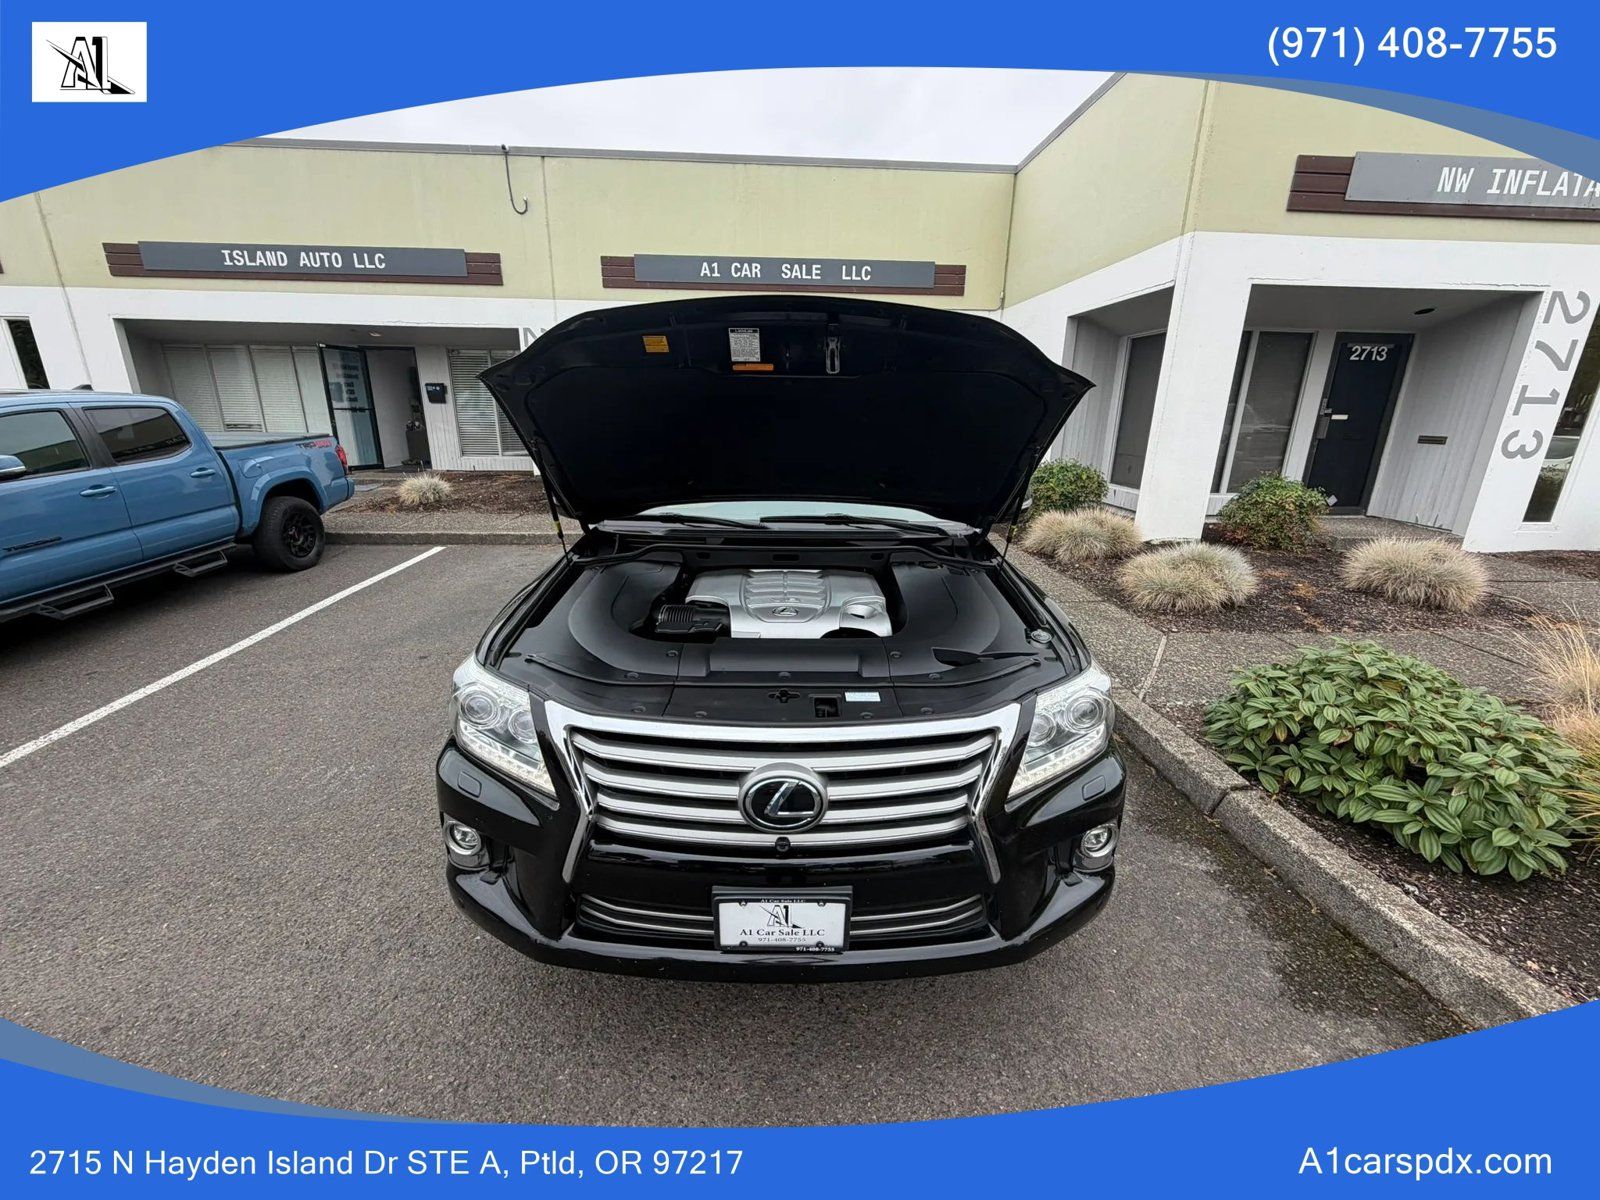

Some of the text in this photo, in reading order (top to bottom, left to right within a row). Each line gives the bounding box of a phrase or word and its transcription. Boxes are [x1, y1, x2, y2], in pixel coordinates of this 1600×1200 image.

[1436, 166, 1476, 194] NW
[221, 249, 386, 269] ISLAND AUTO LLC
[699, 261, 872, 281] A1 CAR SALE LLC
[1349, 345, 1388, 361] 2713
[1501, 290, 1591, 460] 2713
[756, 929, 776, 937] Car
[778, 929, 800, 937] Sale
[803, 929, 826, 937] LLC
